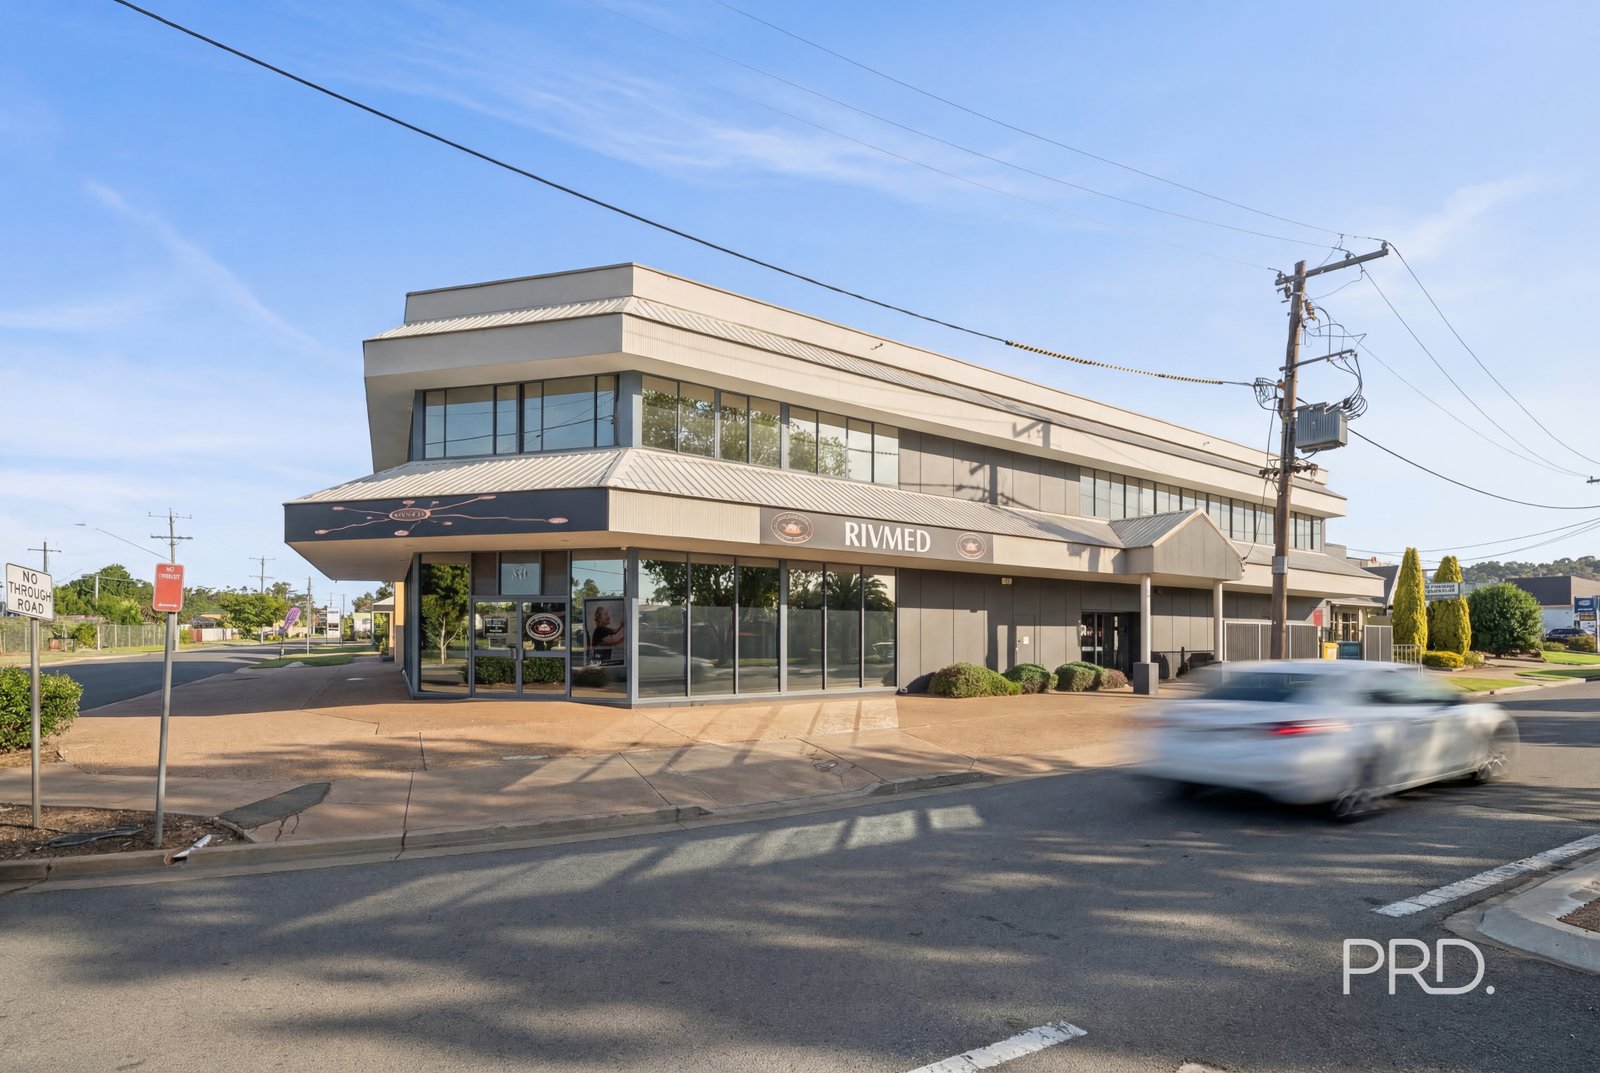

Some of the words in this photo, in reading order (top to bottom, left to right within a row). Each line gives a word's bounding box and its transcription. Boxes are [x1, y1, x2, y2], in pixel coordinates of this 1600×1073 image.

[844, 521, 932, 553] RIVMED
[22, 570, 38, 585] NO
[8, 580, 52, 602] THROUGH
[17, 598, 44, 615] ROAD
